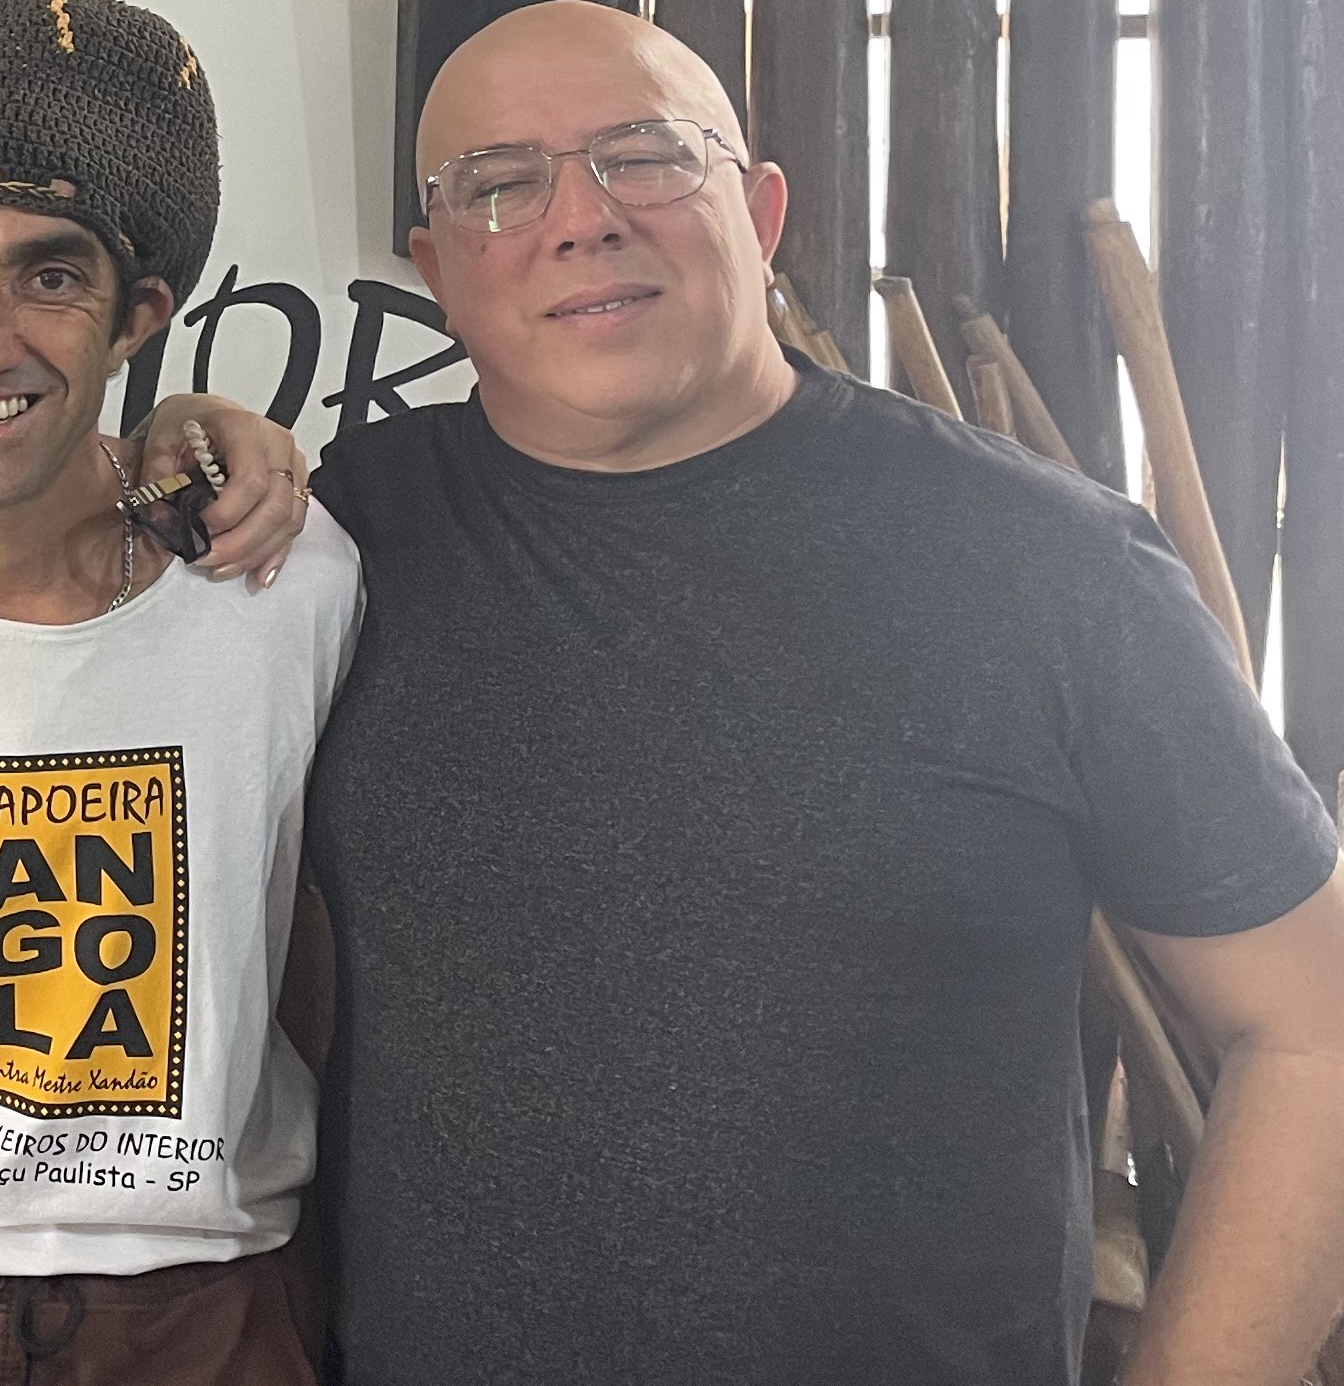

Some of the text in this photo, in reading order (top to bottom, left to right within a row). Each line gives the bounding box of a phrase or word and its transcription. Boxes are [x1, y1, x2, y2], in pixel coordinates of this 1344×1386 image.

[34, 1071, 82, 1094] Mestre
[89, 1067, 158, 1092] Xandão
[77, 1131, 108, 1152] DO
[117, 1132, 226, 1163] INTERIOR
[34, 1161, 135, 1190] Paulista
[167, 1170, 200, 1192] SP
